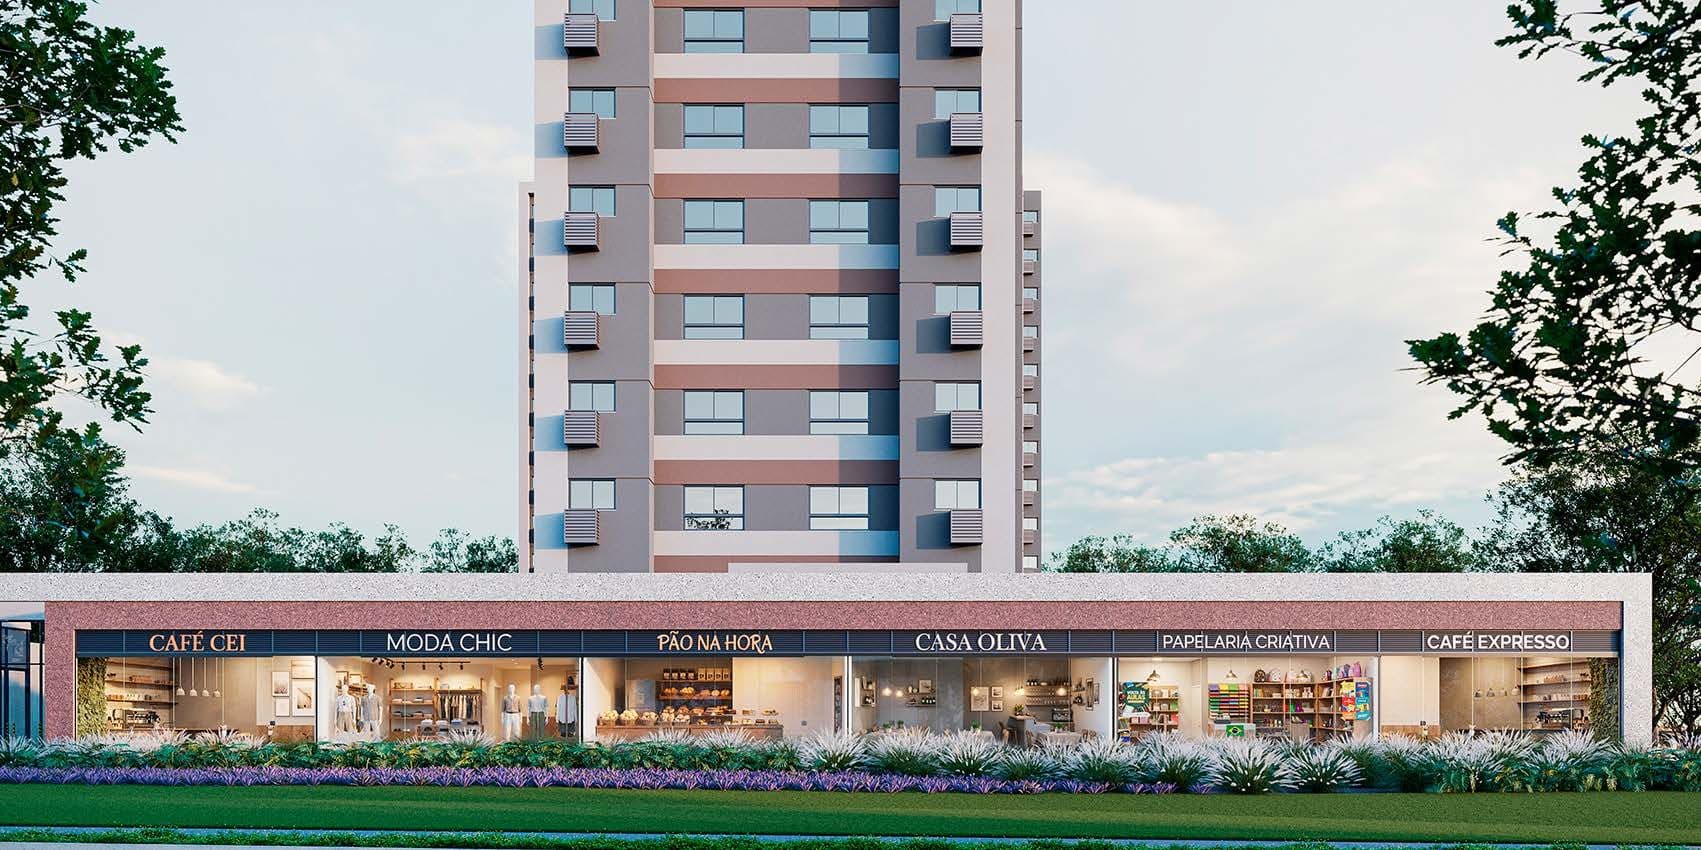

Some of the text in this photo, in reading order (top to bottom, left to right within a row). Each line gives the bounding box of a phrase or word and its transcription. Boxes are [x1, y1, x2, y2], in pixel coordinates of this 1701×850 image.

[149, 631, 246, 651] CAFÉ CEI
[387, 634, 512, 651] MODA CHIC
[657, 631, 773, 653] PÃO NA HORA
[915, 633, 1047, 651] CASA OLIVA
[1163, 635, 1330, 649] PAPELARIA CRIATIVA
[1427, 630, 1570, 650] CAFÉ EXPRESSO
